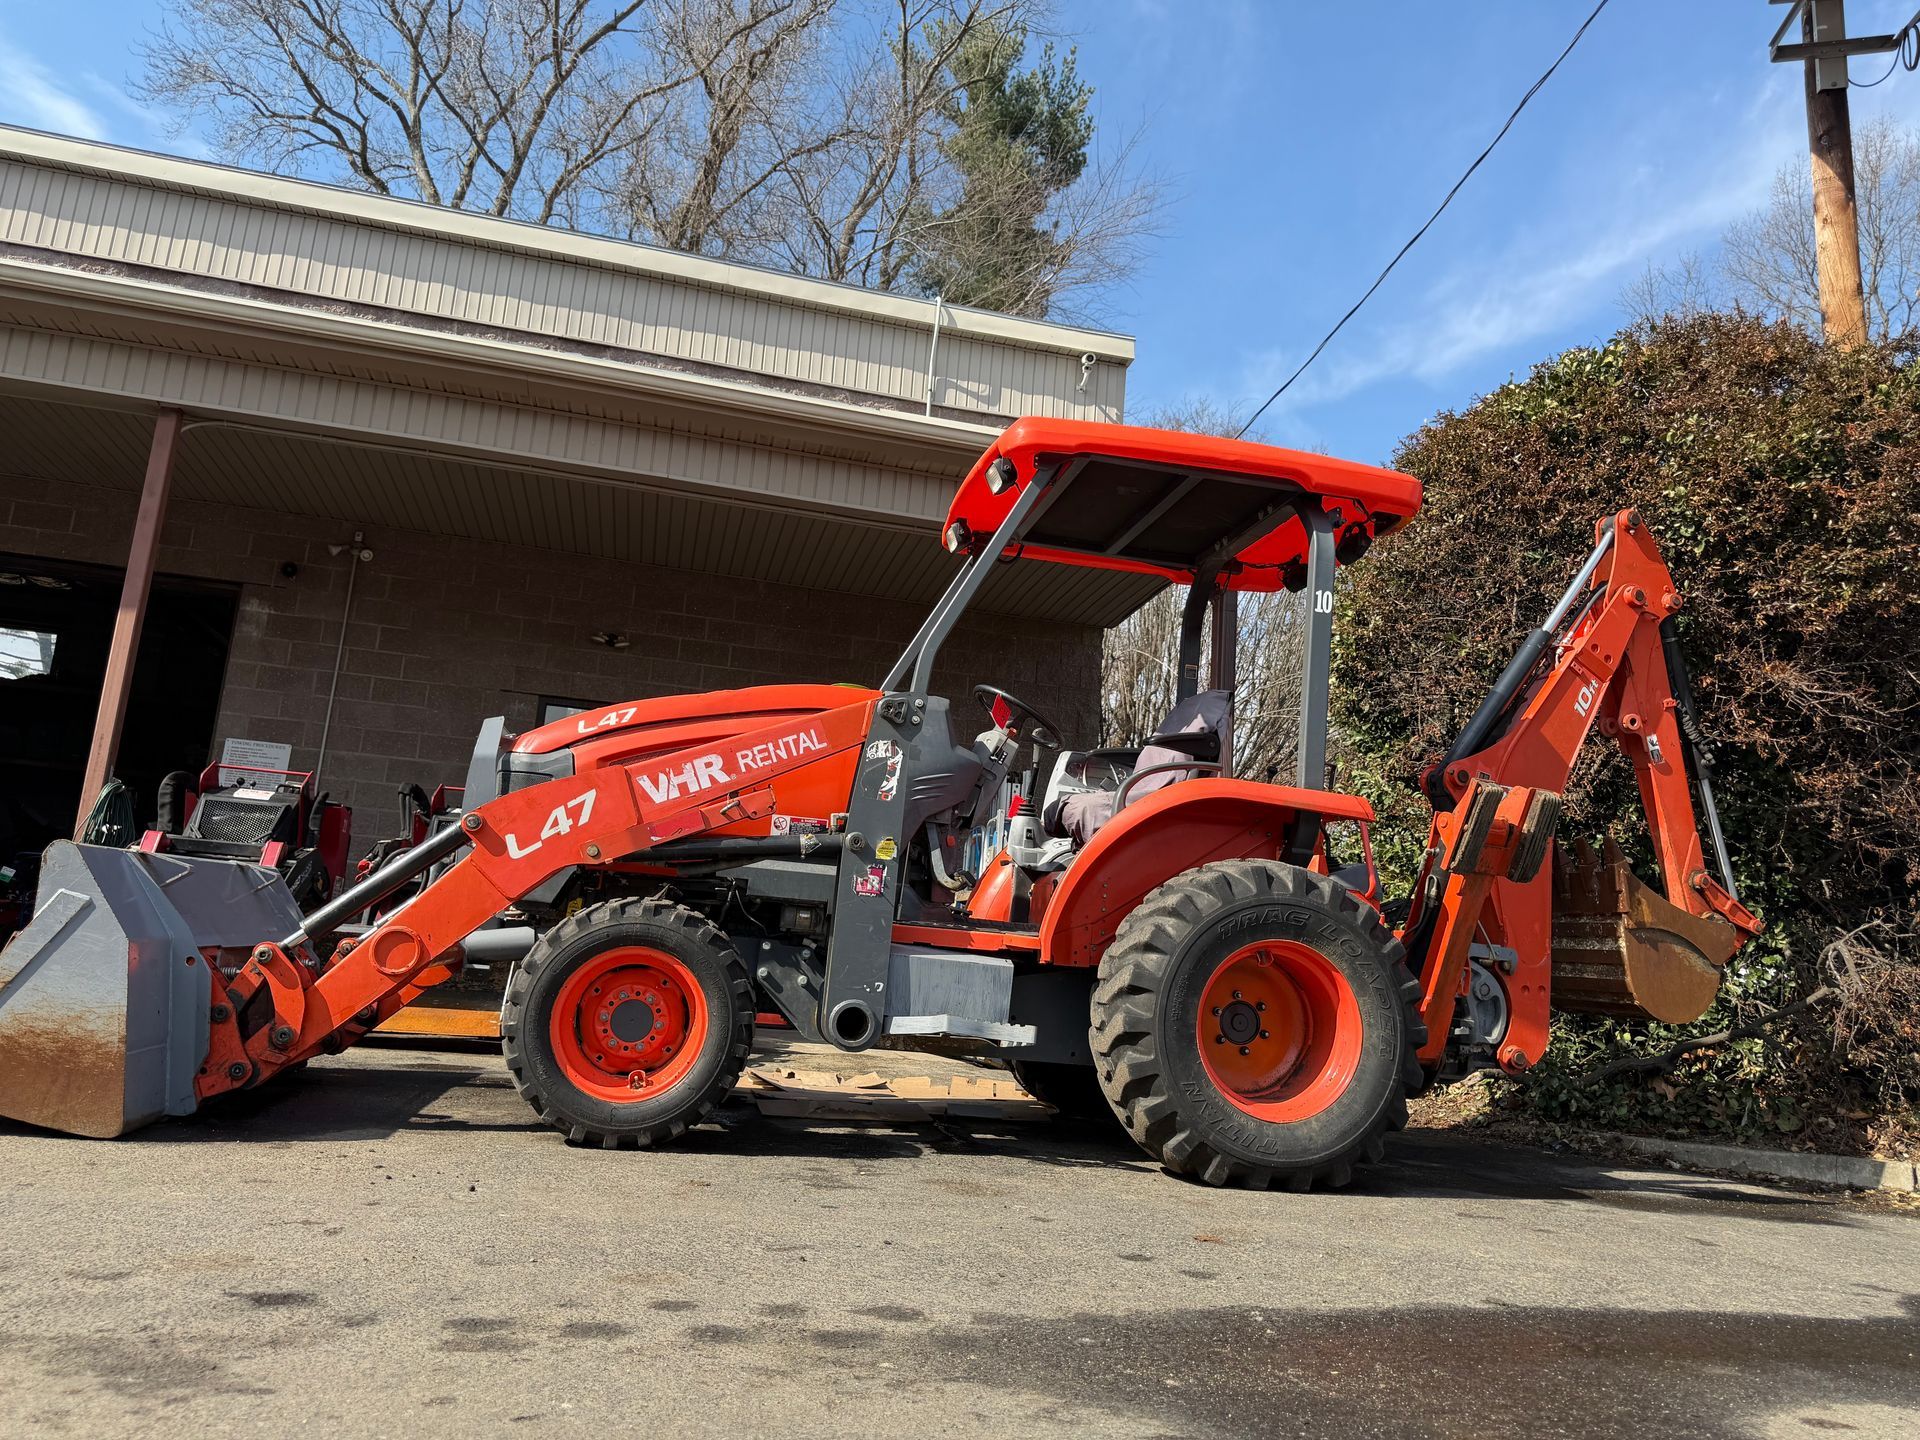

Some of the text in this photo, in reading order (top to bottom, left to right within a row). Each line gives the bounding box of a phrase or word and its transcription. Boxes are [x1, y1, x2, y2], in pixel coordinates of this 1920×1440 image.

[1314, 590, 1333, 614] 10
[577, 707, 638, 734] L47
[636, 754, 731, 804] VHR
[736, 728, 828, 773] RENTAL
[505, 788, 597, 860] L47
[1217, 908, 1398, 1061] TRAC LOADER
[1181, 1081, 1280, 1155] TITAN
